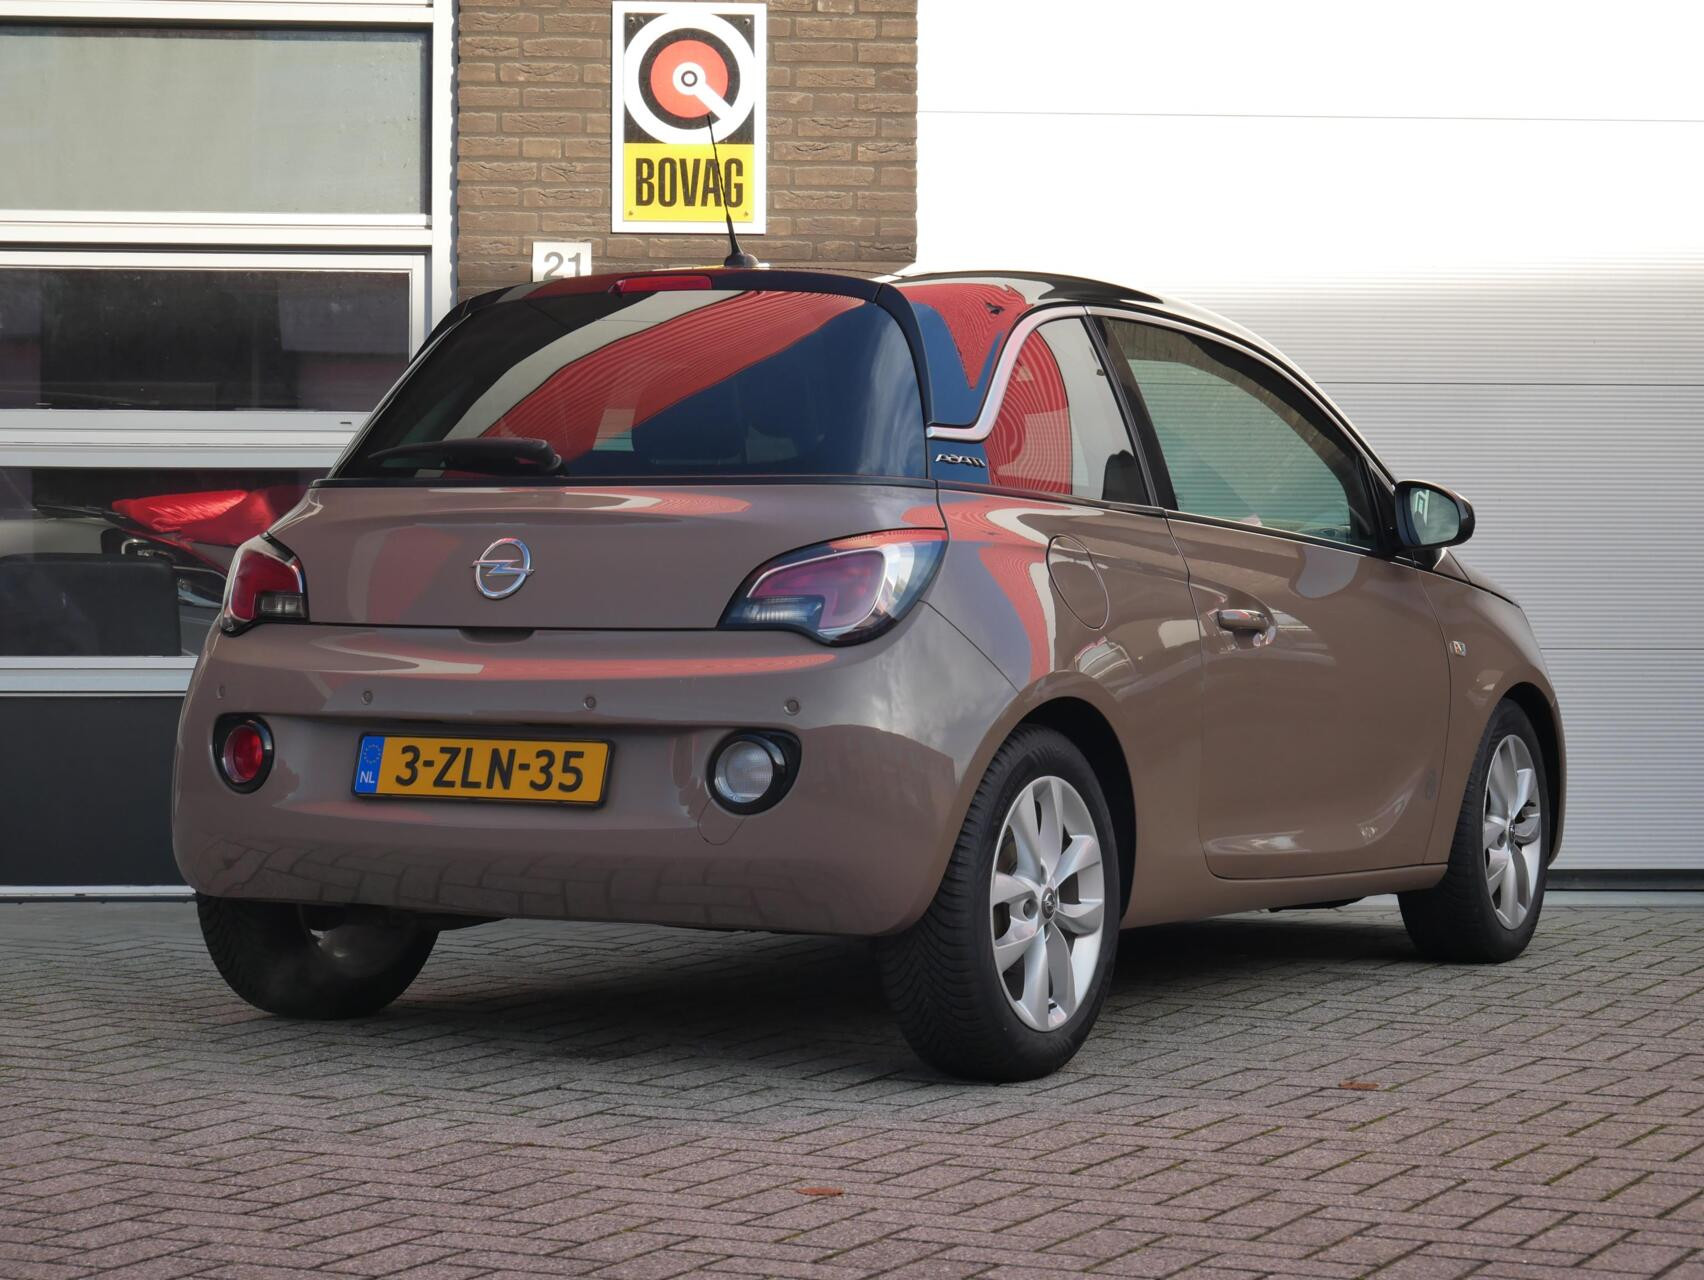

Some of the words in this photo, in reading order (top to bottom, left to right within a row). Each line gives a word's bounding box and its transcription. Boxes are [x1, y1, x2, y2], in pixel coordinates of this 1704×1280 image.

[635, 157, 743, 208] BOVAG
[543, 251, 581, 281] 21
[359, 770, 376, 785] NL
[395, 744, 585, 793] 3-ZLN-35
